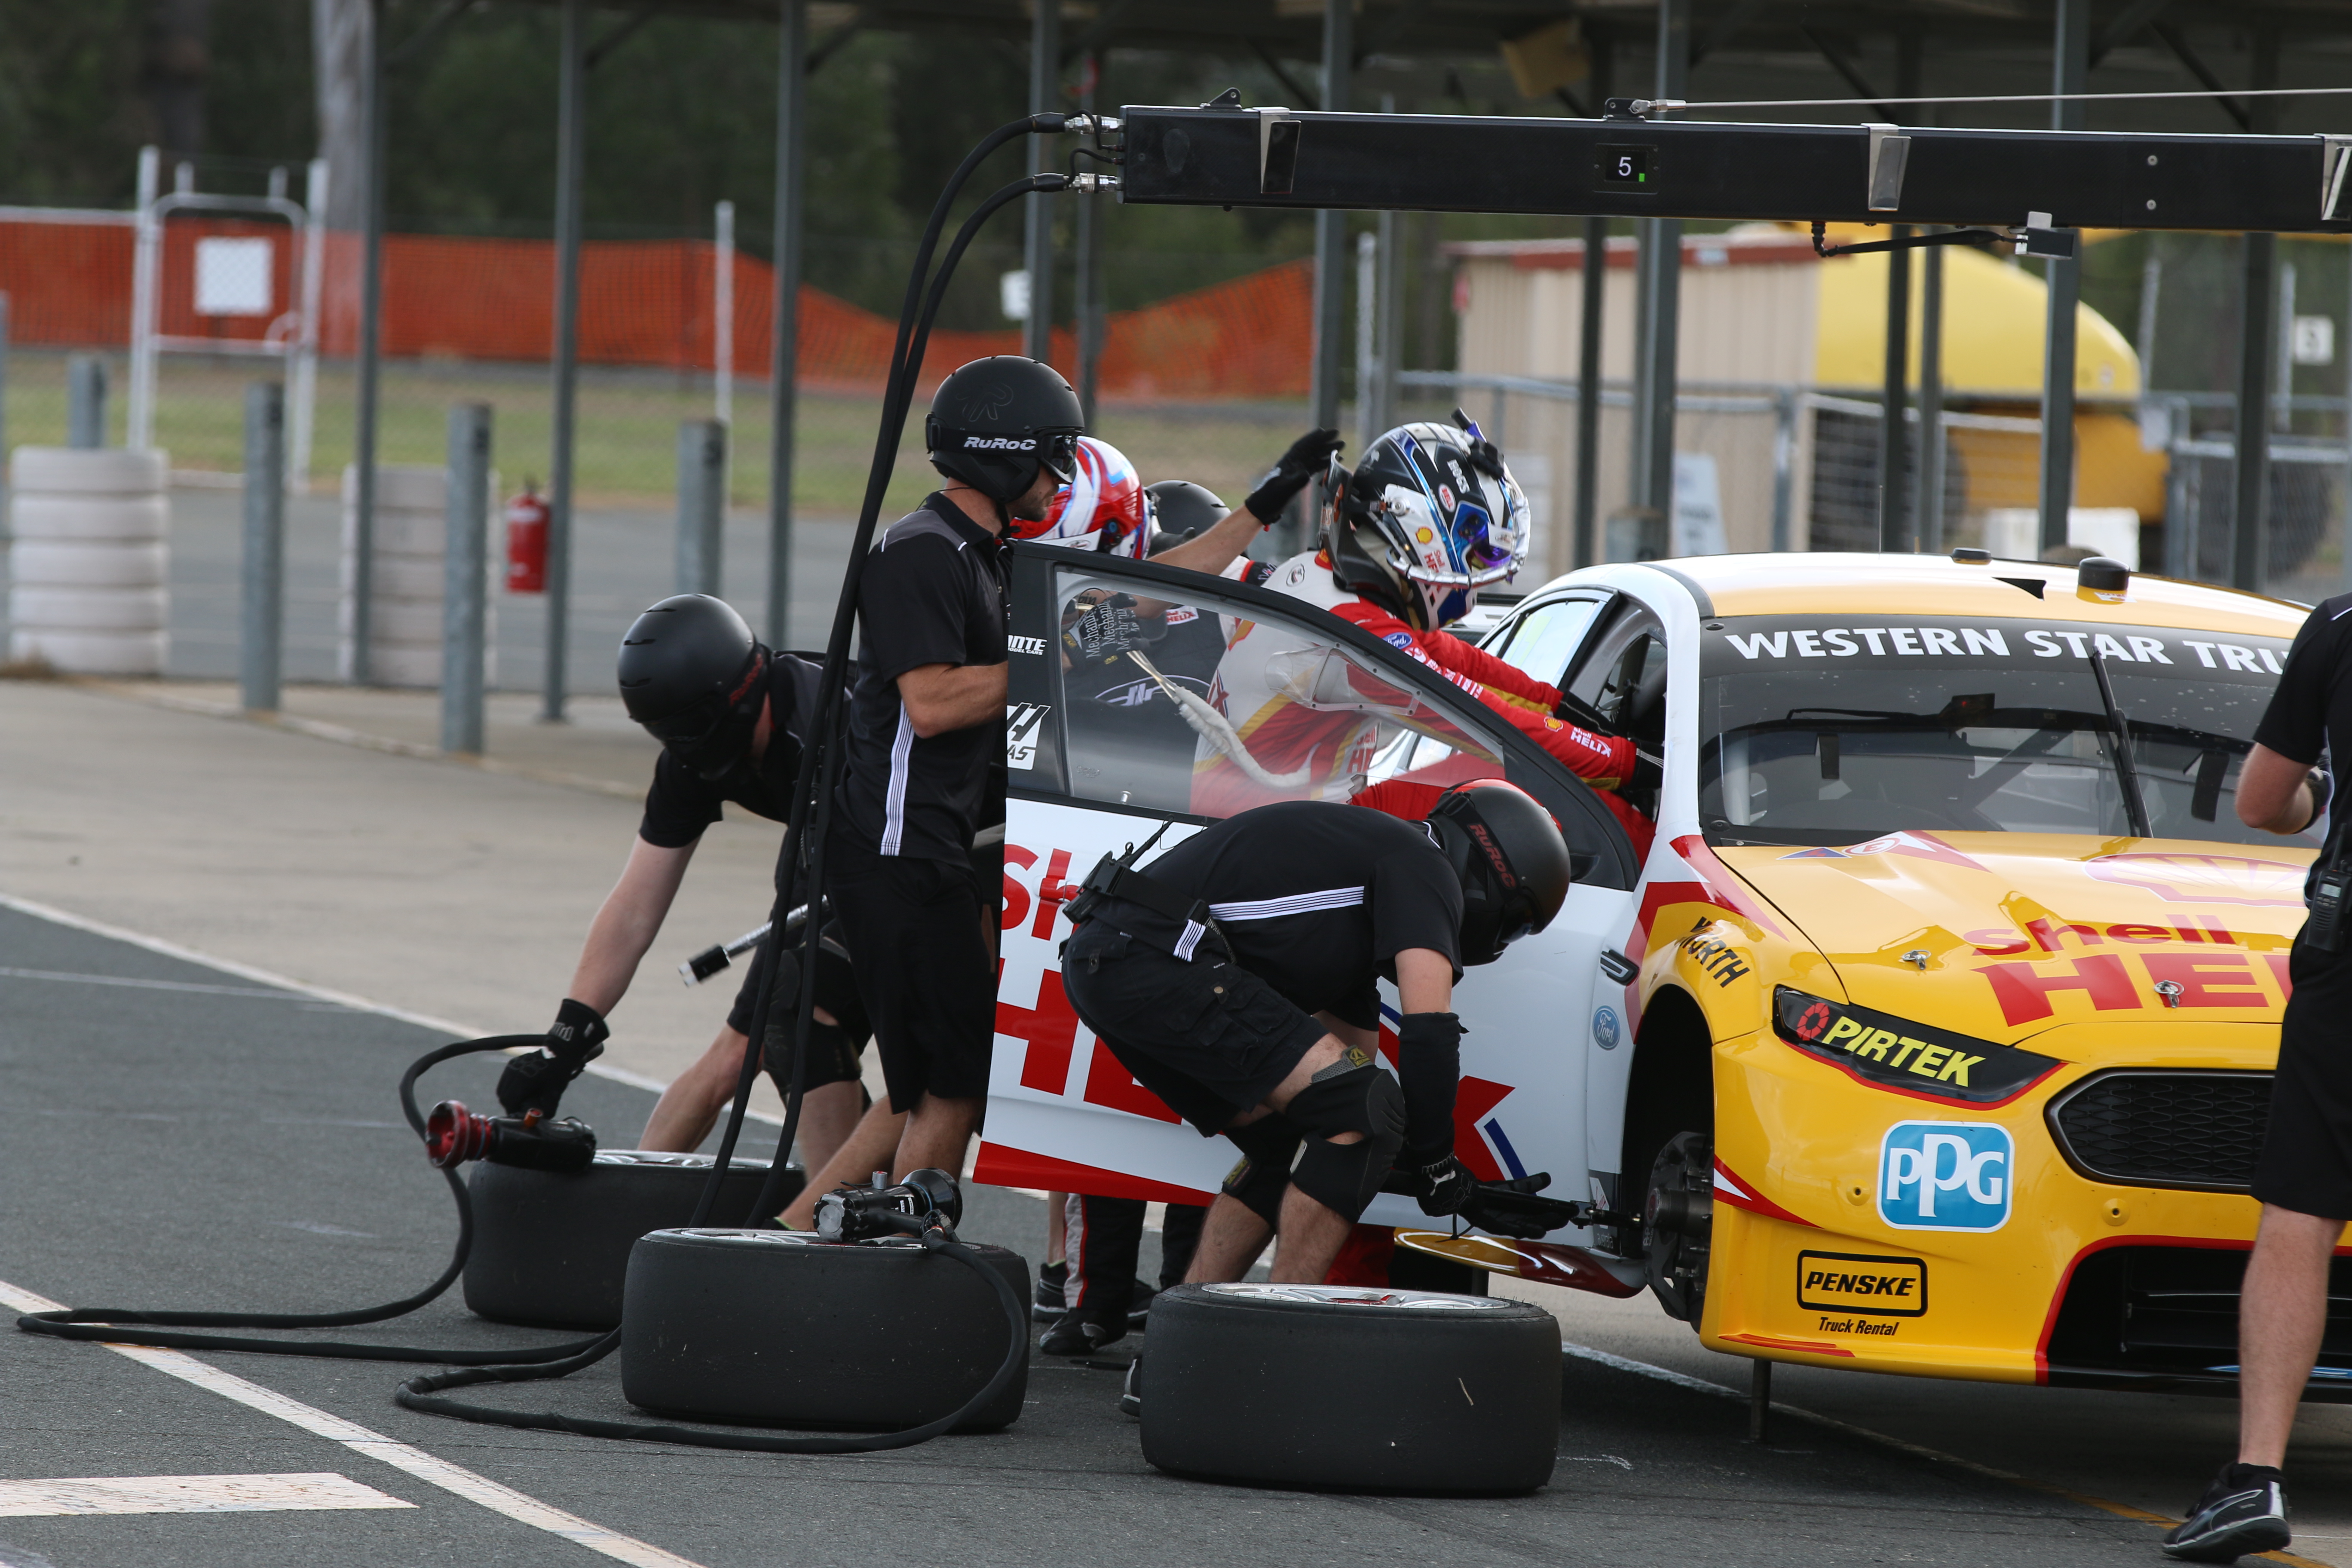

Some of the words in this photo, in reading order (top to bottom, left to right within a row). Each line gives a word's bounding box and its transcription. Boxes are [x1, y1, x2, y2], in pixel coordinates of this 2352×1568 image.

[1618, 156, 1632, 176] 5
[1724, 628, 2011, 660] WESTERN
[2024, 630, 2174, 665] STAR
[1570, 731, 1612, 758] HELIX
[1597, 1012, 1615, 1043] Ford
[1822, 1016, 1986, 1087] PIRTEK
[1886, 1133, 2004, 1217] PPG
[1805, 1271, 1917, 1296] PENSKE
[1818, 1317, 1854, 1333] Truck
[1855, 1319, 1900, 1336] Rental
